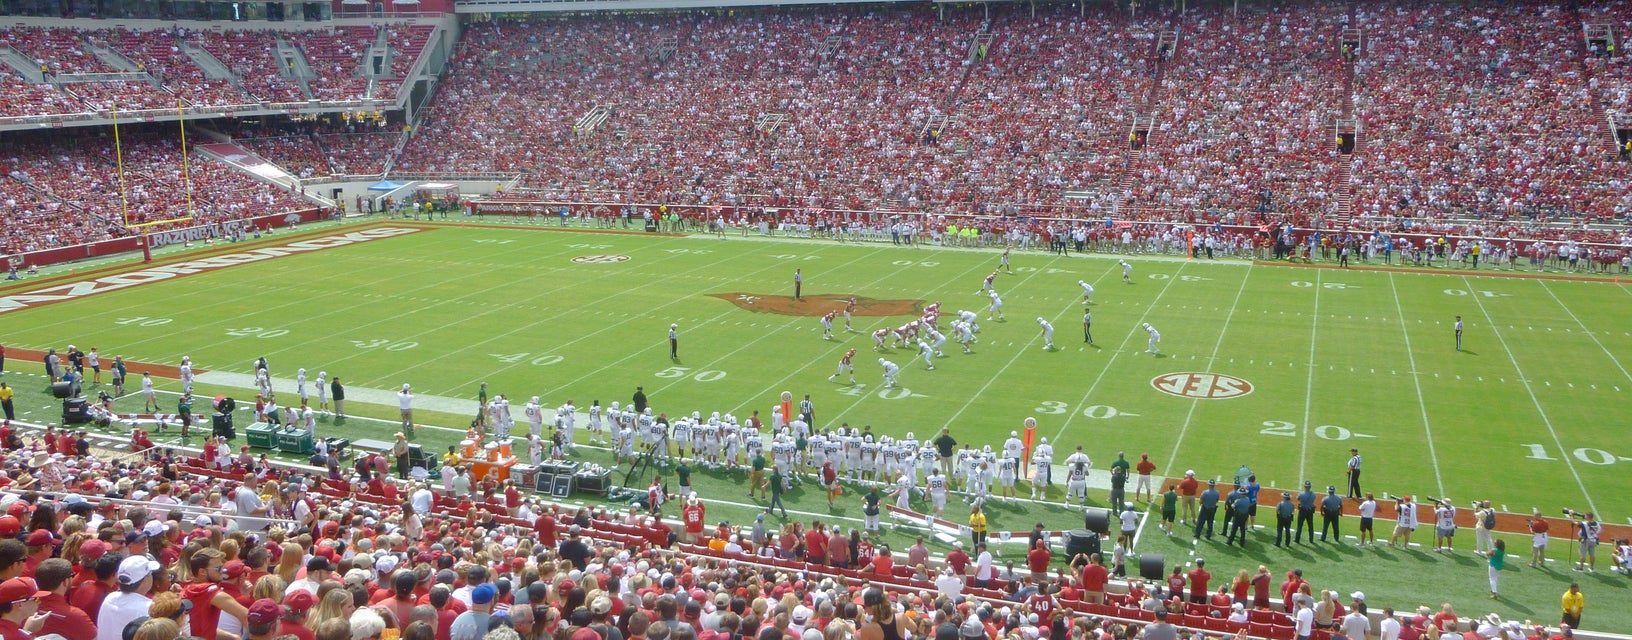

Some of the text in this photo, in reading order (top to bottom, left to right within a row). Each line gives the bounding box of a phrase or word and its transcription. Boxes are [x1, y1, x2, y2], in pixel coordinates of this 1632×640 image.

[0, 226, 420, 312] AZORBACKS
[114, 316, 173, 328] 10
[225, 326, 290, 340] 20
[349, 339, 420, 352] 30
[488, 352, 564, 366] 40
[655, 367, 727, 382] 50
[835, 384, 911, 400] 40
[1157, 373, 1247, 398] SEC
[1035, 400, 1119, 420] 30
[1260, 420, 1351, 442] 20
[923, 451, 933, 459] 25
[1520, 443, 1617, 466] 10
[932, 480, 942, 488] 68
[689, 513, 700, 522] 66
[858, 548, 870, 558] 64
[1035, 600, 1049, 611] 40
